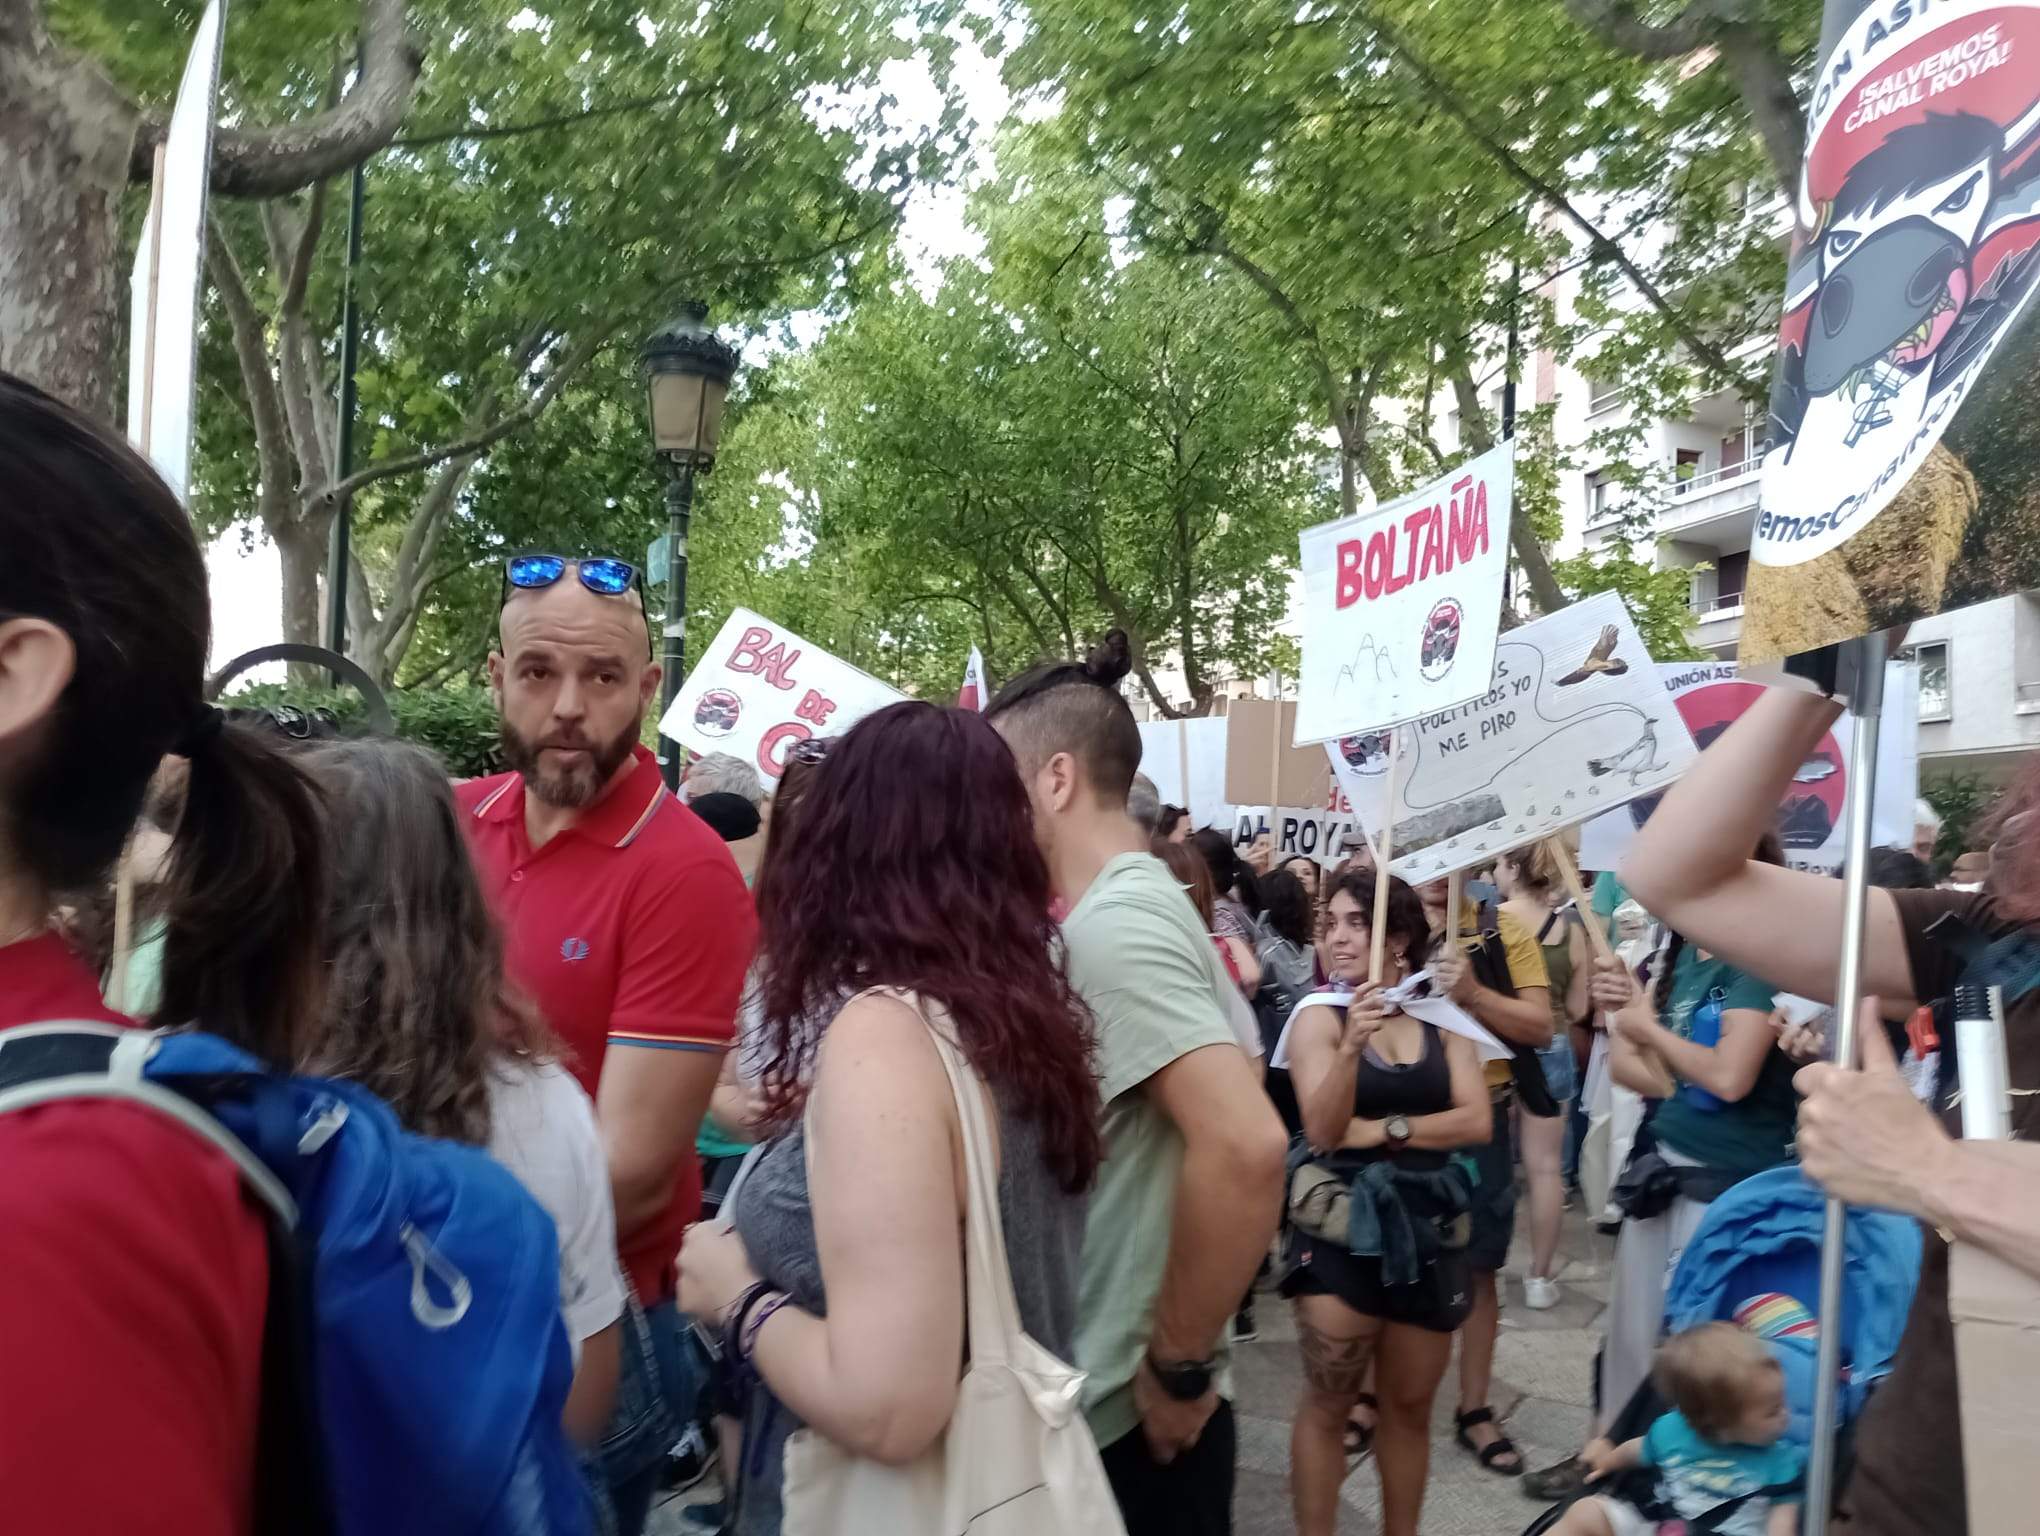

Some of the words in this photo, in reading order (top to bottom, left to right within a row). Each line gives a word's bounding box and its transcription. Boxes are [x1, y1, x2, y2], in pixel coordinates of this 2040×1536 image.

[1844, 84, 1926, 133] CANAL
[1930, 39, 2013, 97] ROYA!
[1336, 474, 1489, 611] BOLTAÑA
[725, 627, 801, 690] BAL
[1664, 667, 1711, 691] UNIÓN
[795, 688, 837, 727] DE
[1511, 675, 1531, 696] YO
[1438, 732, 1469, 758] ME
[1480, 711, 1516, 740] PIRO
